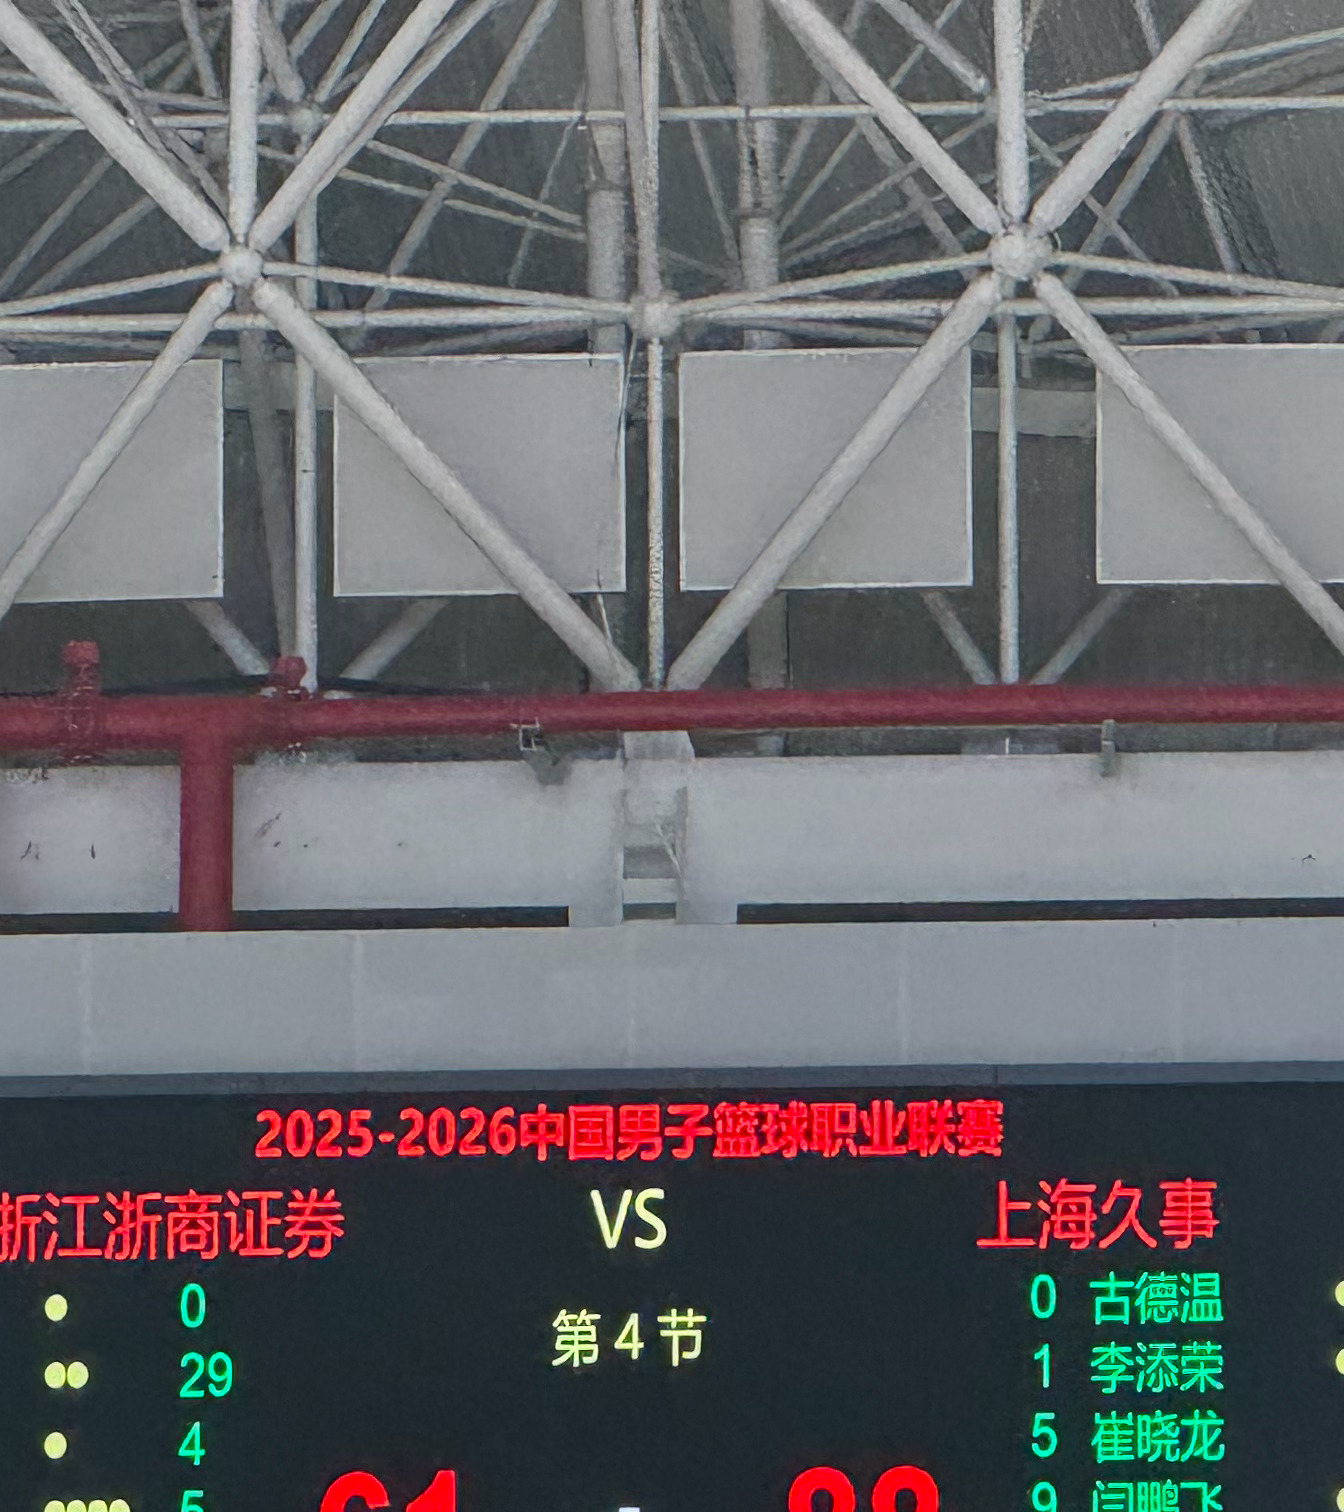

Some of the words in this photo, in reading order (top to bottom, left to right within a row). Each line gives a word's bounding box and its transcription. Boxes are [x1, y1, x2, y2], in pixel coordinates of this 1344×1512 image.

[256, 1100, 1005, 1162] 2025-2026中国男子篮球职业联赛
[591, 1188, 668, 1251] VS
[976, 1178, 1221, 1252] 上海久事
[180, 1283, 205, 1328] 0
[1031, 1274, 1056, 1318] 0
[1090, 1272, 1224, 1325] 古德温
[180, 1352, 232, 1397] 29
[1034, 1344, 1049, 1388] 1
[1091, 1341, 1224, 1394] 李添荣
[178, 1422, 205, 1465] 4
[1032, 1413, 1057, 1457] 5
[1091, 1409, 1225, 1463] 崔晓龙
